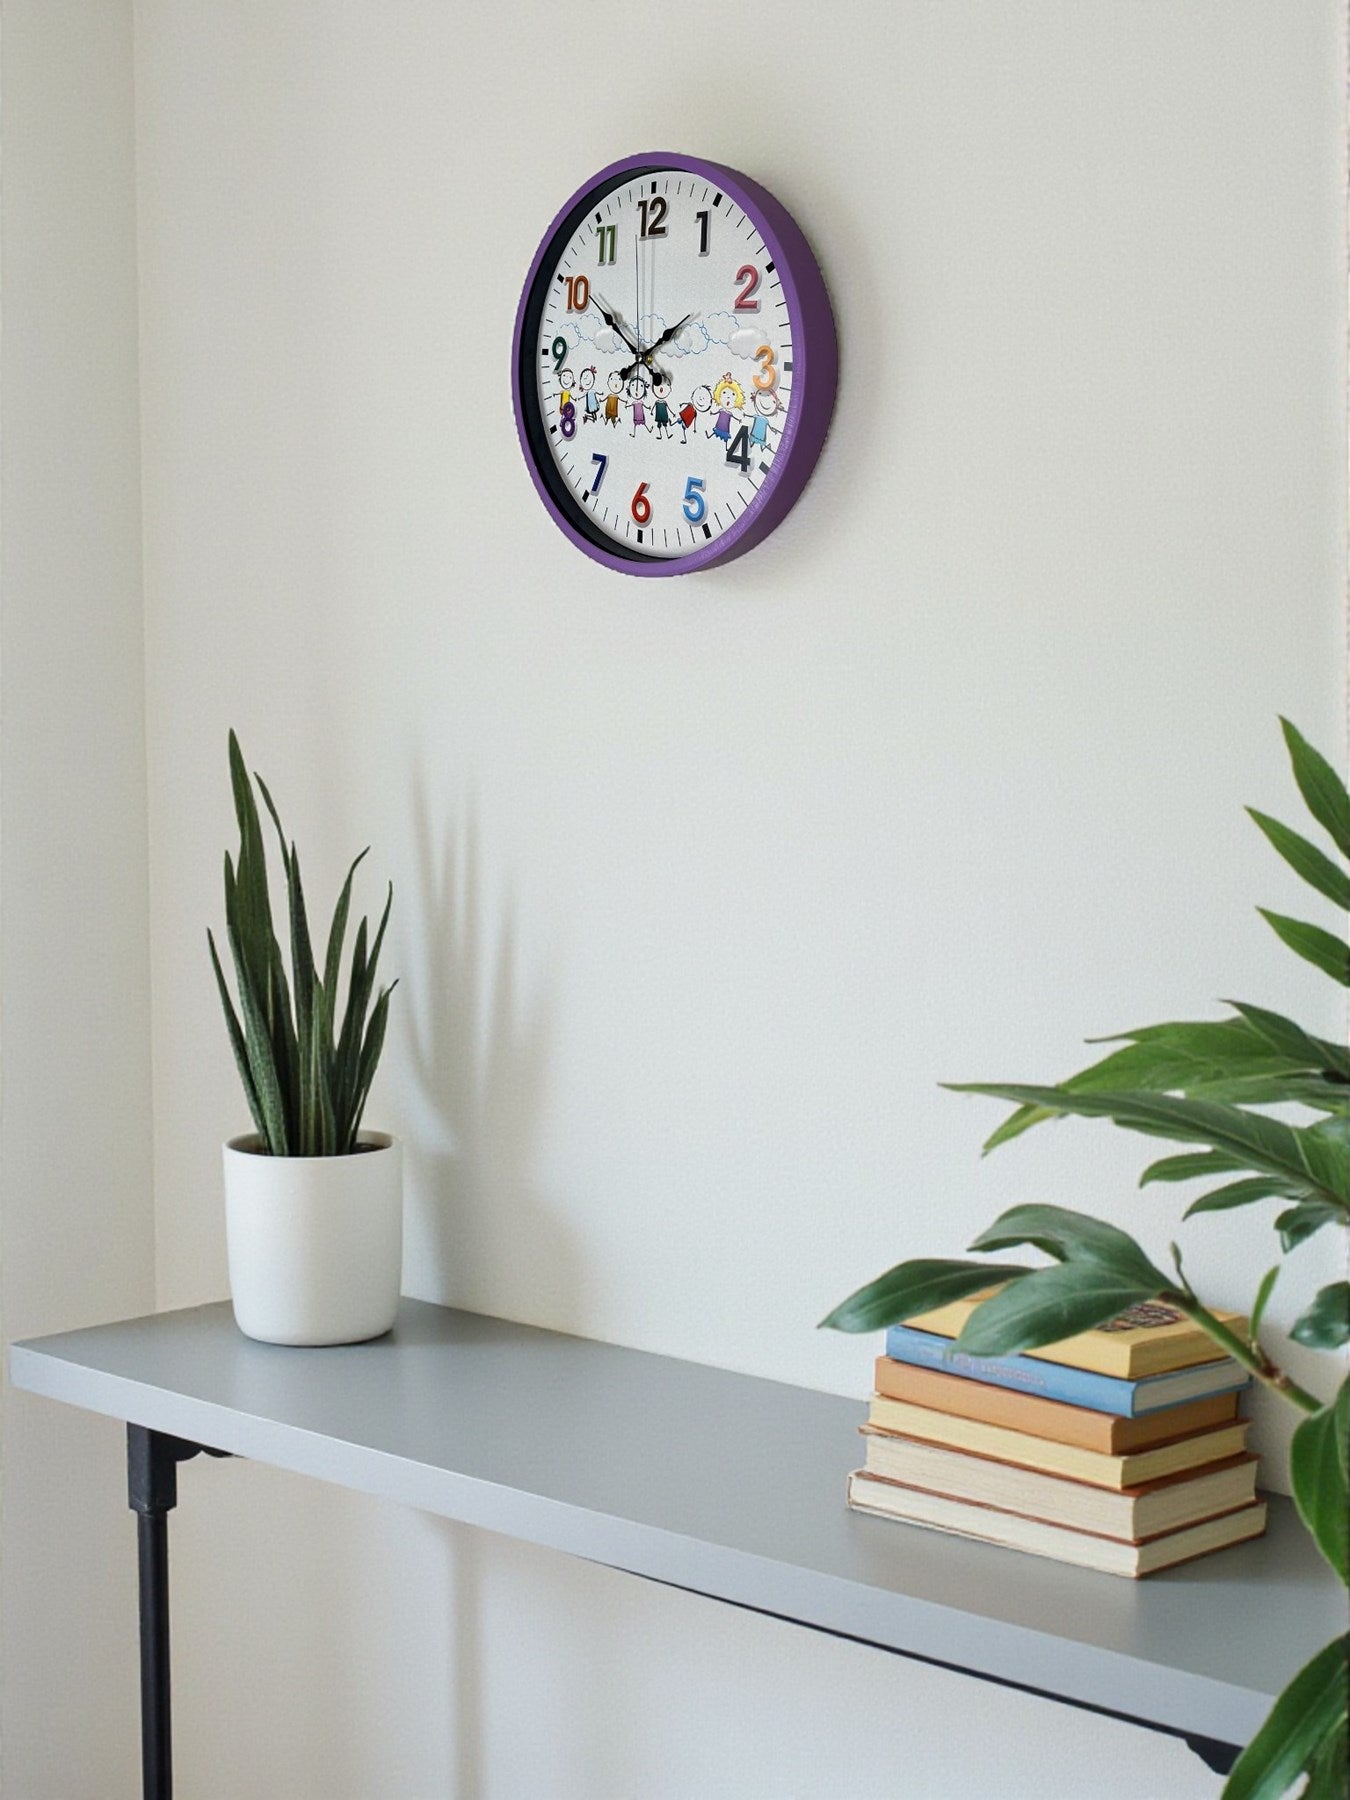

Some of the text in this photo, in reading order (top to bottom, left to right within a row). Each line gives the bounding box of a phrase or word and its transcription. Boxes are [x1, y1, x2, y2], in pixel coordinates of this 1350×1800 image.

[638, 196, 666, 238] 12
[696, 210, 709, 254] 1
[597, 225, 616, 264] 11
[565, 276, 589, 312] 10
[735, 265, 760, 310] 2
[552, 337, 567, 370] 9
[753, 345, 776, 389] 3
[560, 402, 576, 439] 8
[726, 425, 751, 472] 4
[591, 454, 606, 492] 7
[631, 482, 651, 523] 6
[682, 476, 705, 523] 5
